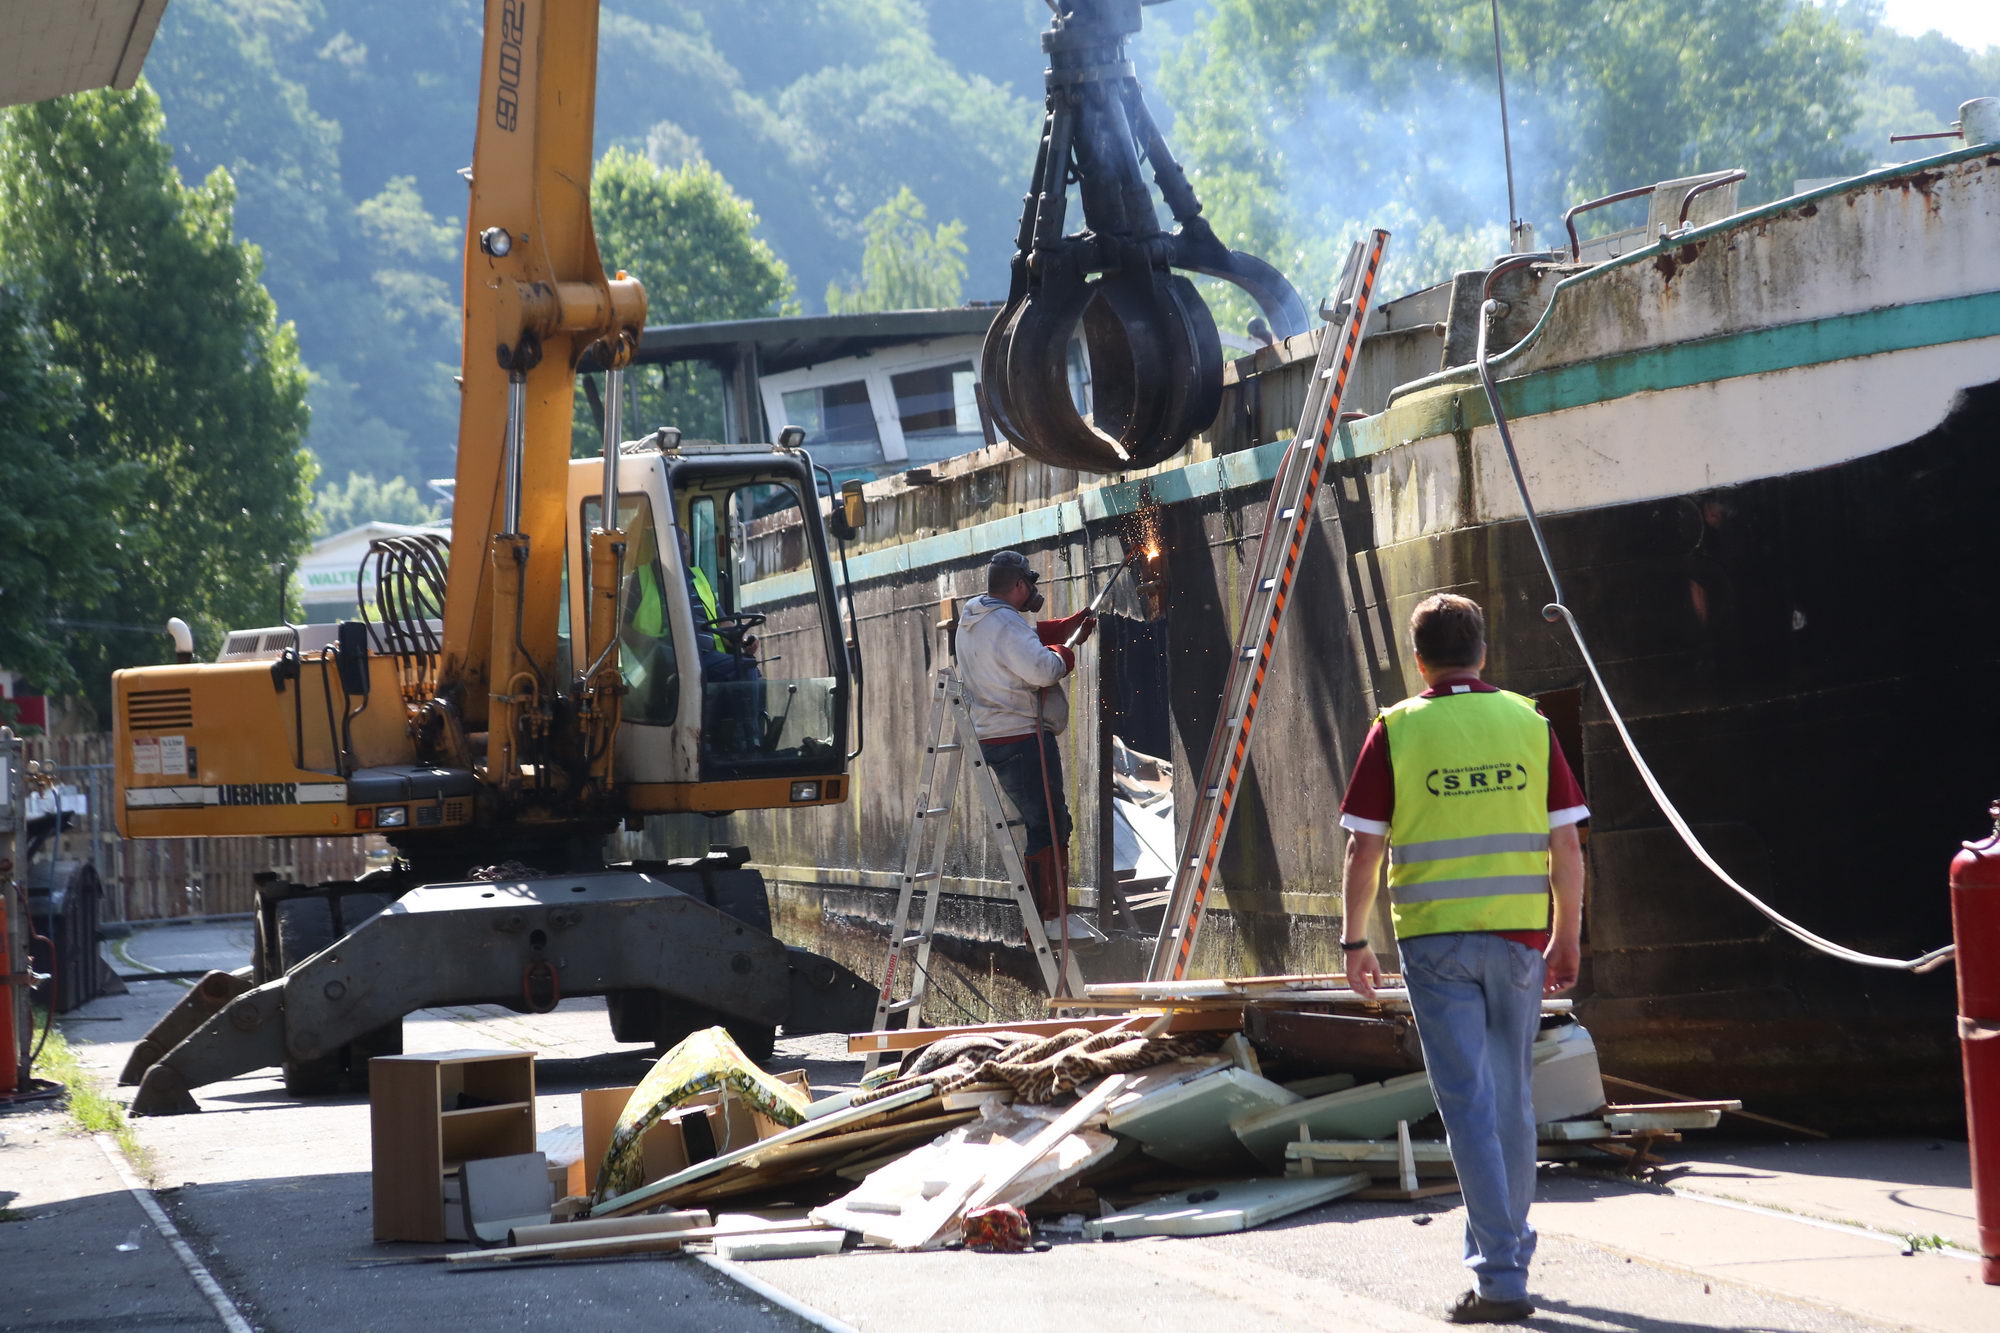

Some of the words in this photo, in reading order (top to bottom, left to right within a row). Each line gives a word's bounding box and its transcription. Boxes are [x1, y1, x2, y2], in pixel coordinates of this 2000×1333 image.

[496, 0, 525, 132] 902
[307, 569, 372, 587] WALTER
[218, 783, 298, 805] LIEBHERR
